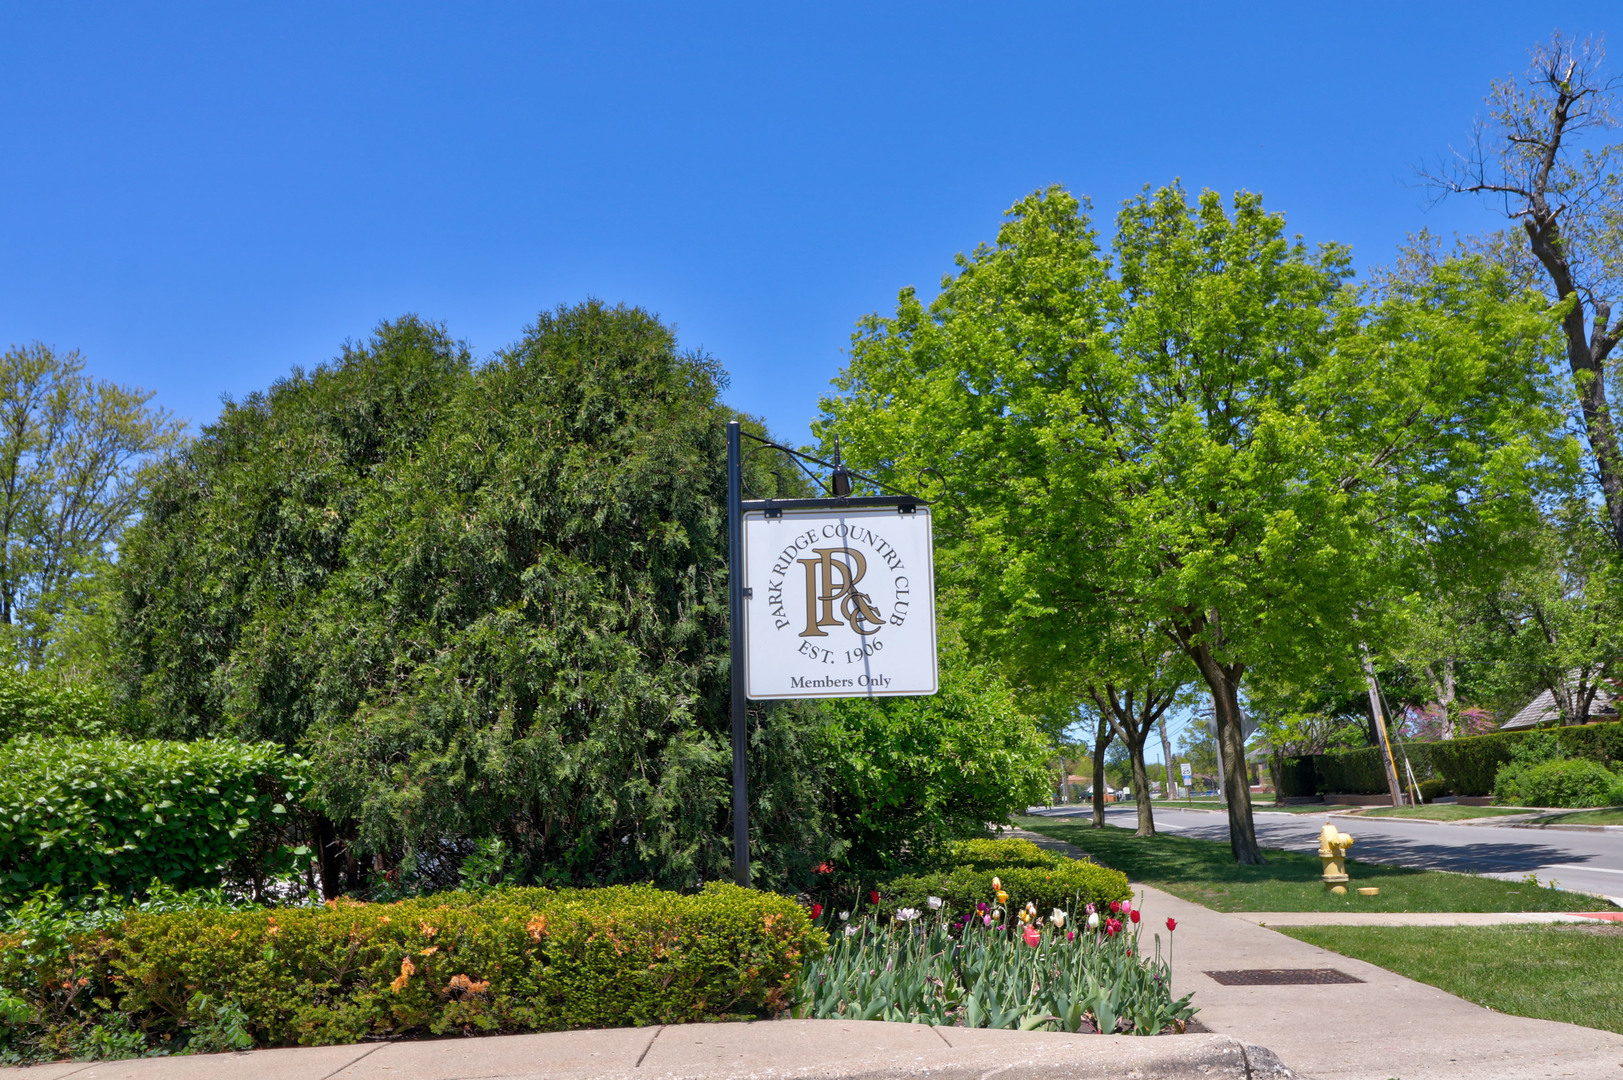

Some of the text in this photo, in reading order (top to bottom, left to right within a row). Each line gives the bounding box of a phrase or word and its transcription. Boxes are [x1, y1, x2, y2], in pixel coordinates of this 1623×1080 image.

[768, 524, 910, 631] PARK RIDGE COUNTRY CLUB
[798, 637, 883, 664] EST. 1906
[791, 674, 891, 688] Members Only
